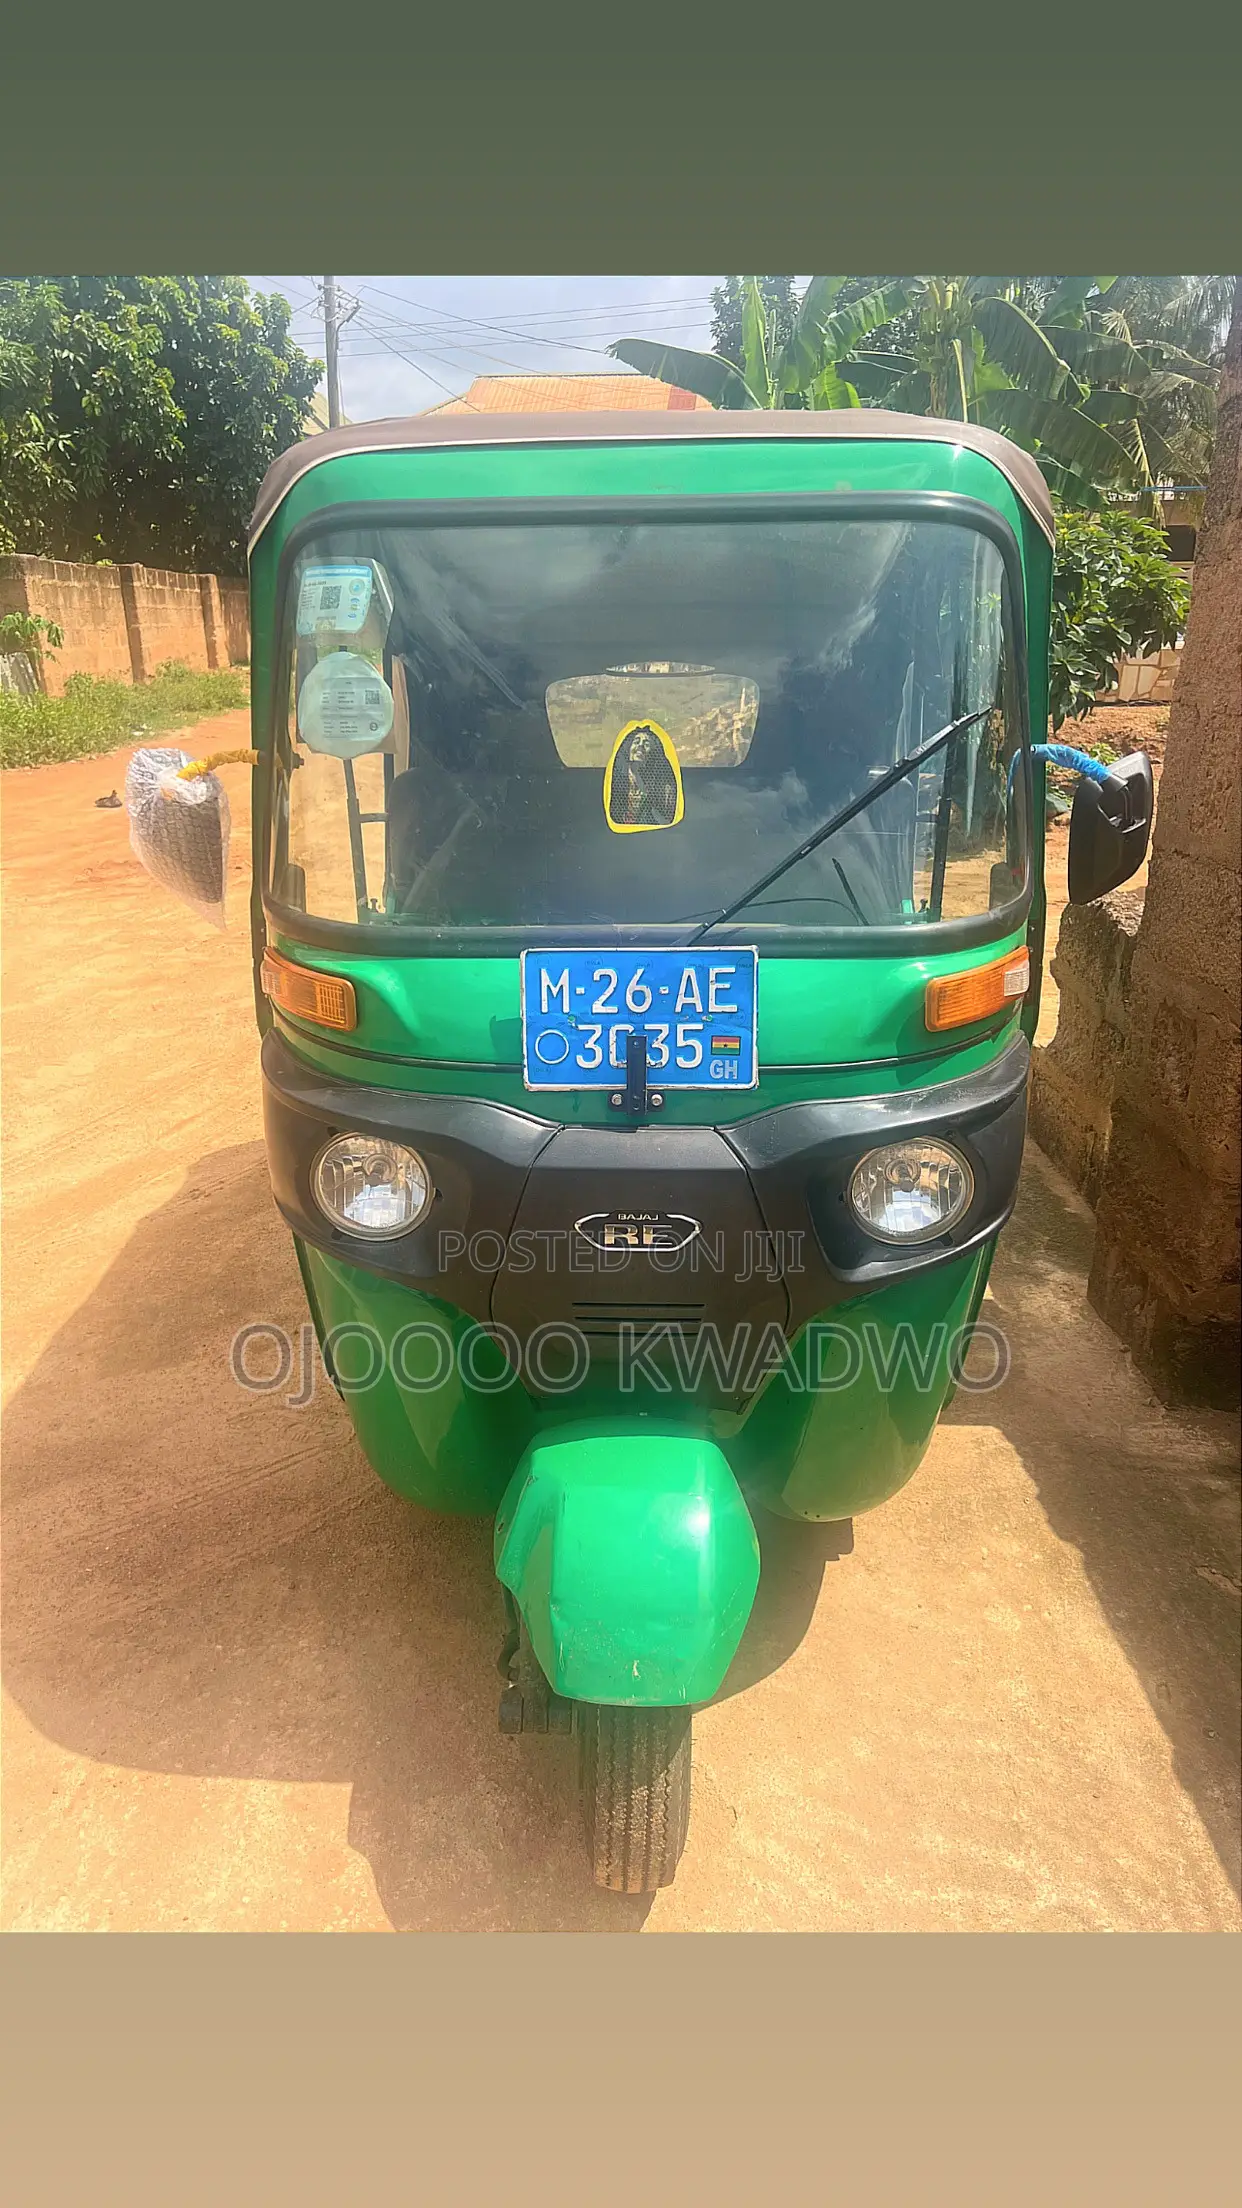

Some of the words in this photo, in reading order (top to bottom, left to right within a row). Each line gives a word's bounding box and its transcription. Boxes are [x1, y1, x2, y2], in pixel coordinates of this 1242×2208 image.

[540, 967, 738, 1014] M-26-AE
[709, 1060, 738, 1079] GH
[617, 1213, 660, 1221] BAJAJ
[604, 1223, 673, 1245] RE
